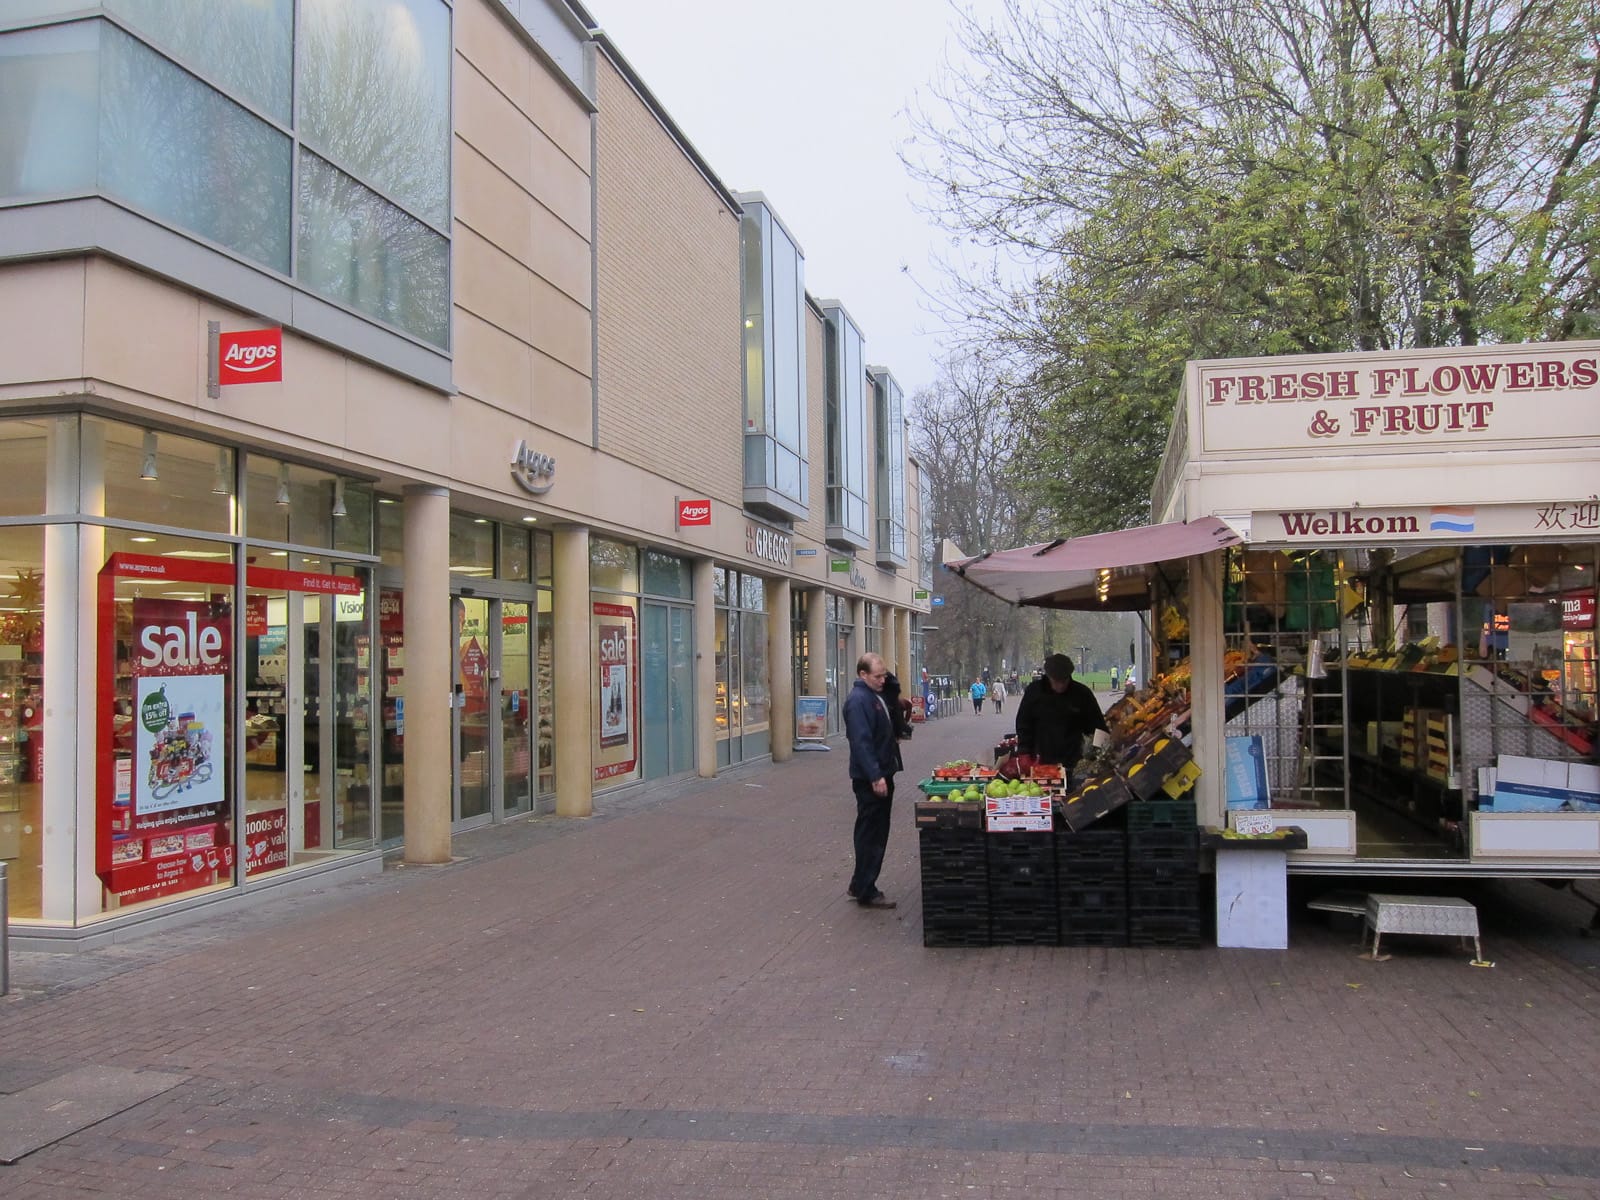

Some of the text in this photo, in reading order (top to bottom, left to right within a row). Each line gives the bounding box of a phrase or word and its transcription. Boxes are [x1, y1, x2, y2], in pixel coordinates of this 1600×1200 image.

[225, 344, 277, 364] Argos
[1207, 359, 1600, 403] FRESH FLOWERS
[1308, 401, 1494, 437] & FRUIT
[511, 440, 555, 479] Argos
[681, 505, 709, 517] Argos
[1278, 511, 1420, 536] Welkom
[1535, 502, 1600, 531] 欢迎
[755, 527, 790, 565] GREGGS
[303, 577, 315, 587] Find
[321, 580, 331, 589] Get
[337, 582, 351, 592] Argos
[141, 611, 222, 668] sale
[601, 631, 625, 661] sale
[245, 815, 284, 835] 1000s of
